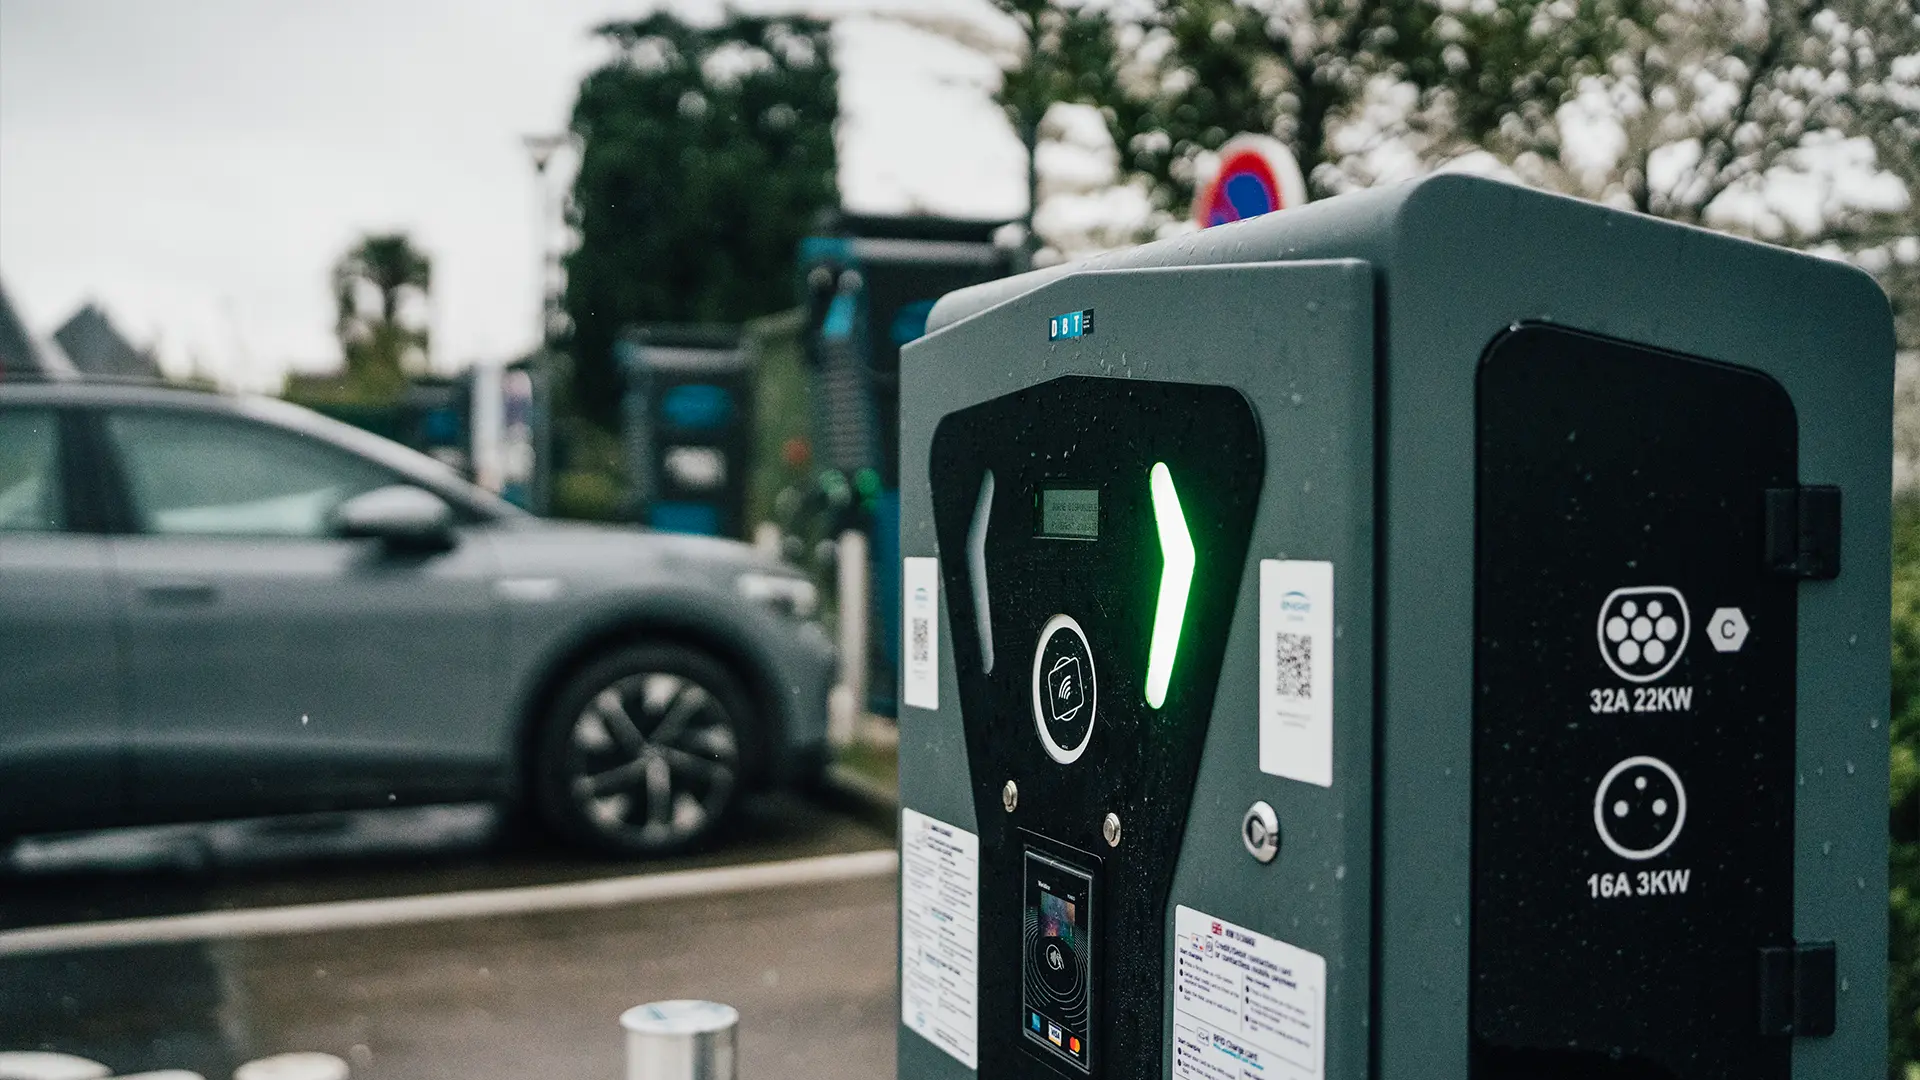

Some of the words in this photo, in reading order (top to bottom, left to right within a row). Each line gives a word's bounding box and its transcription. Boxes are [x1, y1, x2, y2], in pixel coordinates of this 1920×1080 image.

[1051, 315, 1080, 338] DBT
[1720, 619, 1736, 640] C
[1589, 688, 1629, 713] 32A
[1633, 686, 1693, 712] 22KW
[1587, 871, 1632, 898] 16A
[1636, 868, 1691, 896] 3KW
